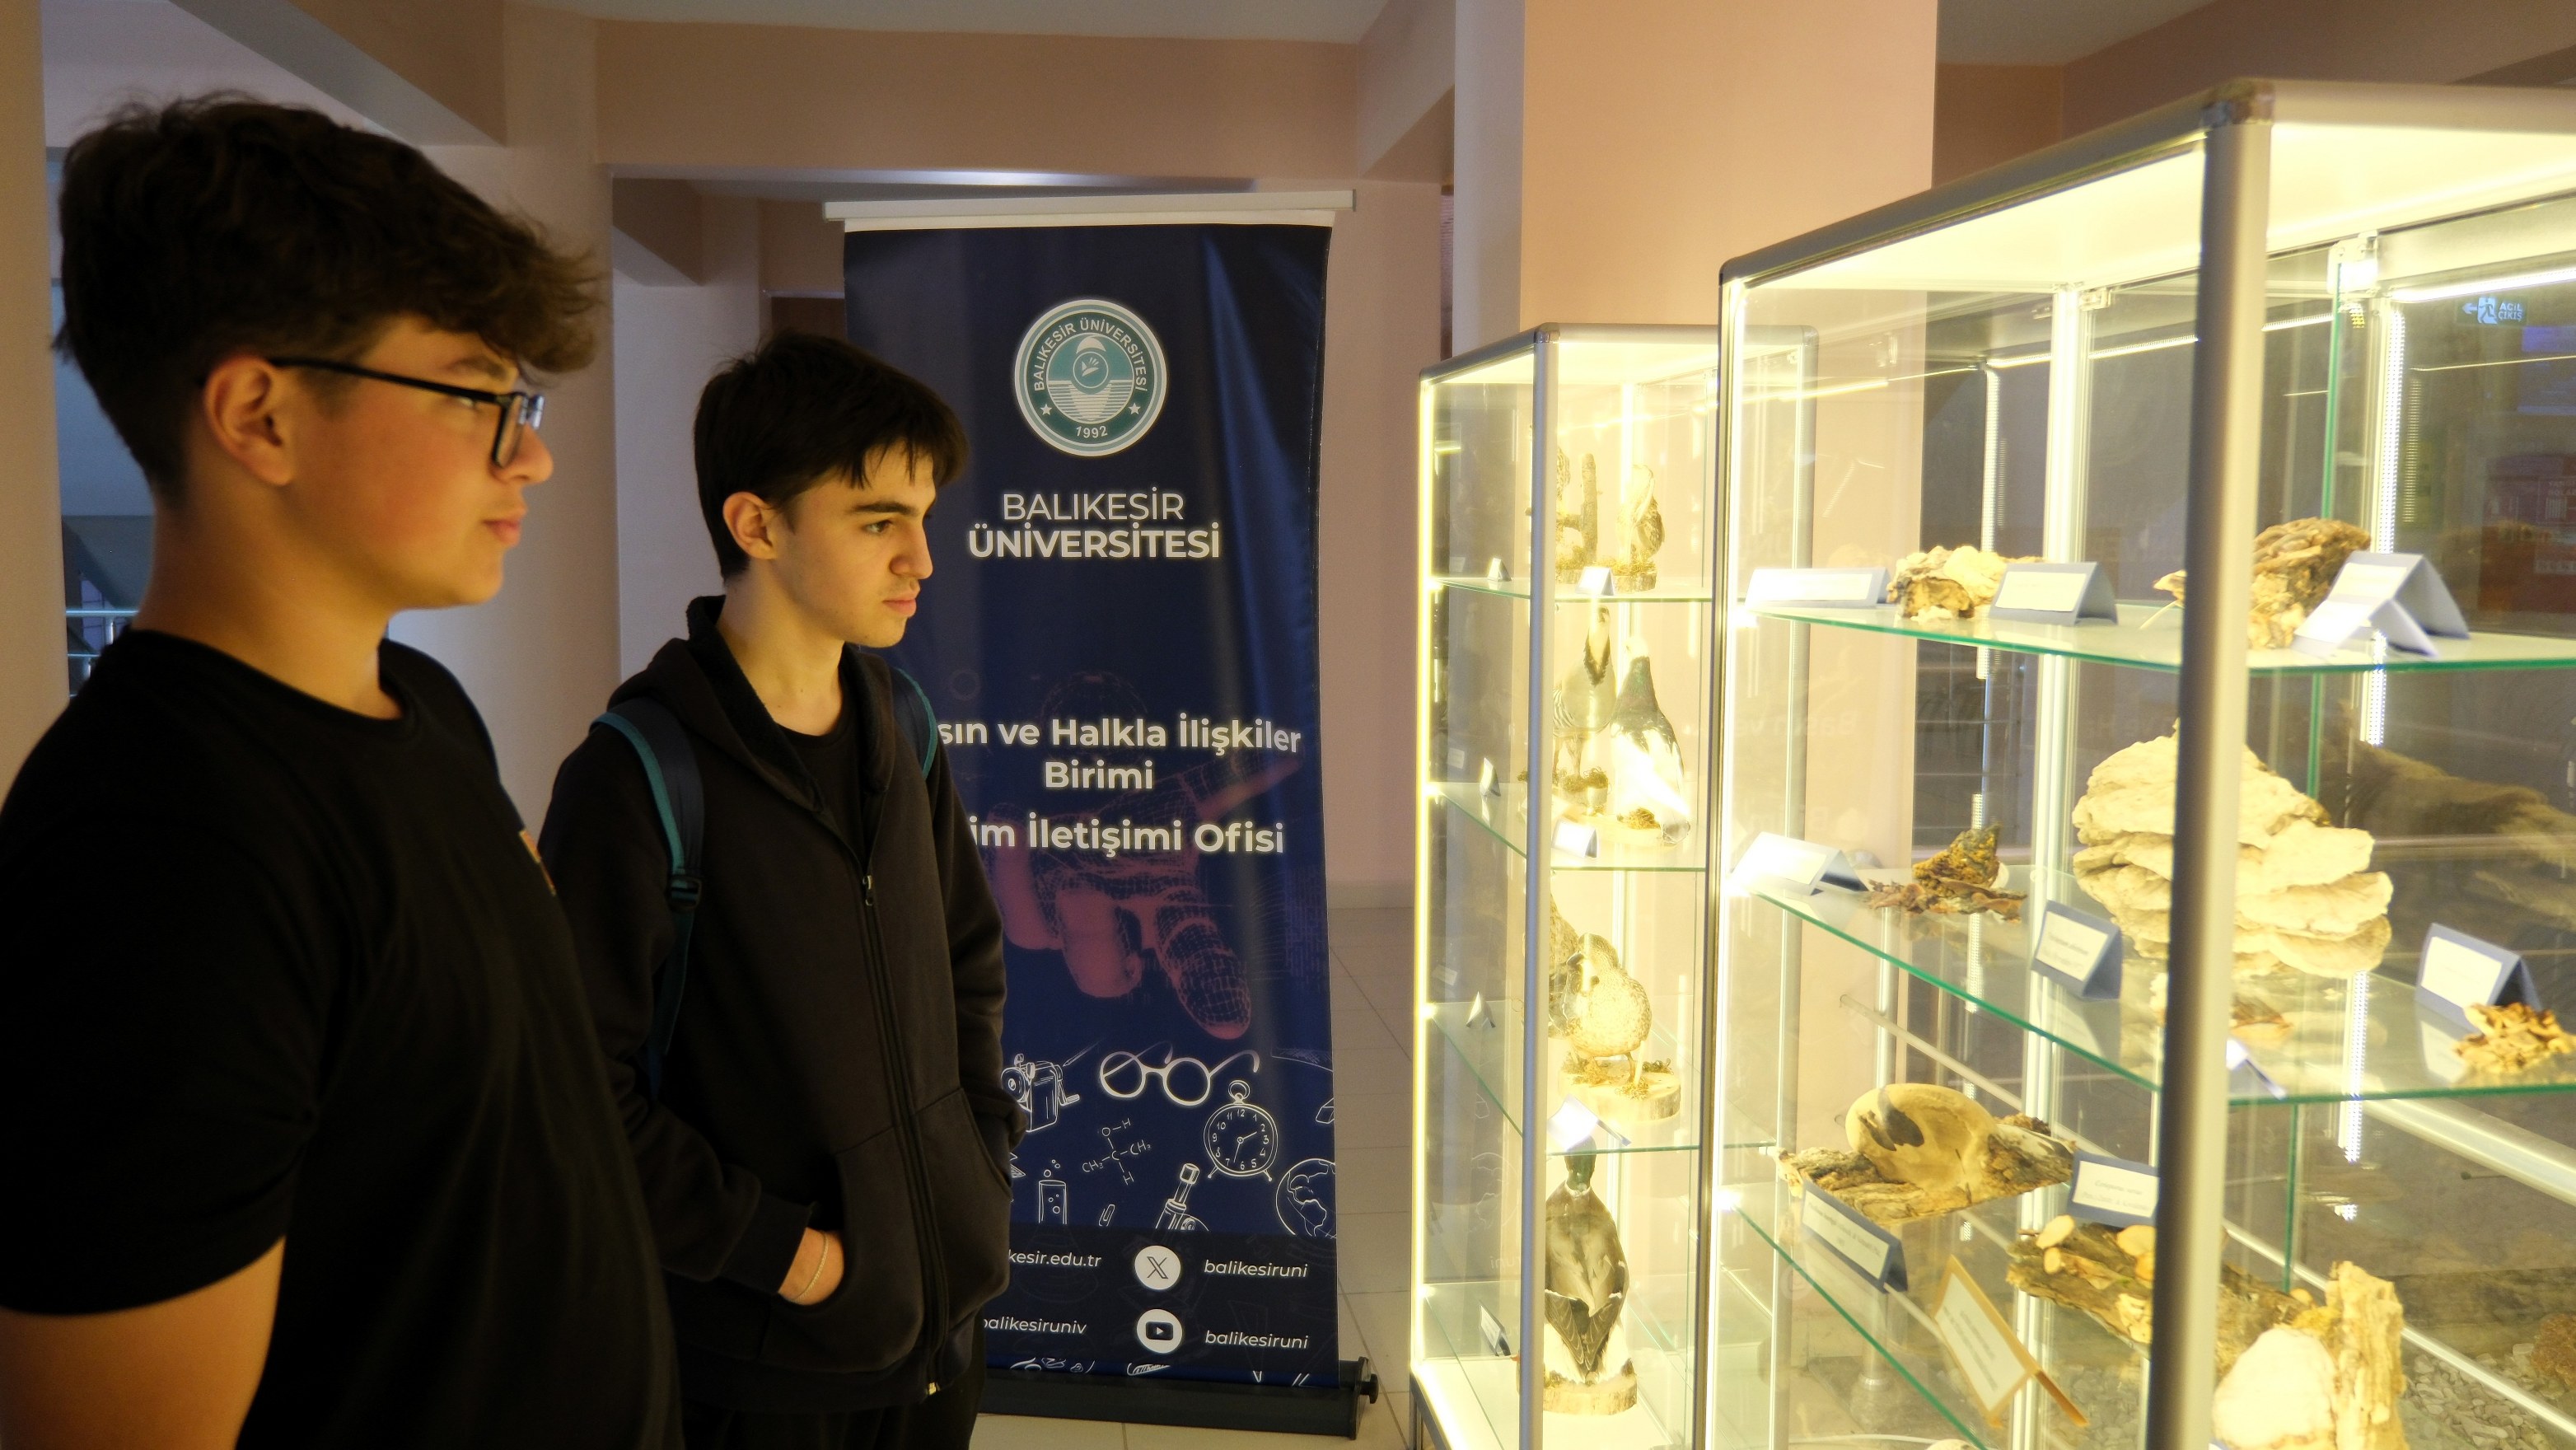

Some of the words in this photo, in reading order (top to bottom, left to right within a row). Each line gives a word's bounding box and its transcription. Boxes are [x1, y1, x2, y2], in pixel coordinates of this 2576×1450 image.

[1033, 322, 1077, 391] BALIKESİR
[1079, 317, 1148, 392] ÜNİVERSİTESİ
[1076, 425, 1108, 438] 1992
[1003, 487, 1185, 521] BALIKESİR
[968, 522, 1221, 559] ÜNİVERSİTESİ
[937, 719, 988, 745] sın
[998, 723, 1040, 746] ve
[1052, 718, 1166, 747] Halkla
[1180, 713, 1302, 755] İlişkiler
[1045, 760, 1153, 789] Birimi
[1029, 812, 1182, 858] İletişimi
[1194, 821, 1284, 854] Ofisi
[1008, 1249, 1102, 1268] kesir.edu.tr
[1204, 1259, 1308, 1277] balikesiruni
[1205, 1330, 1309, 1349] balikesiruni
